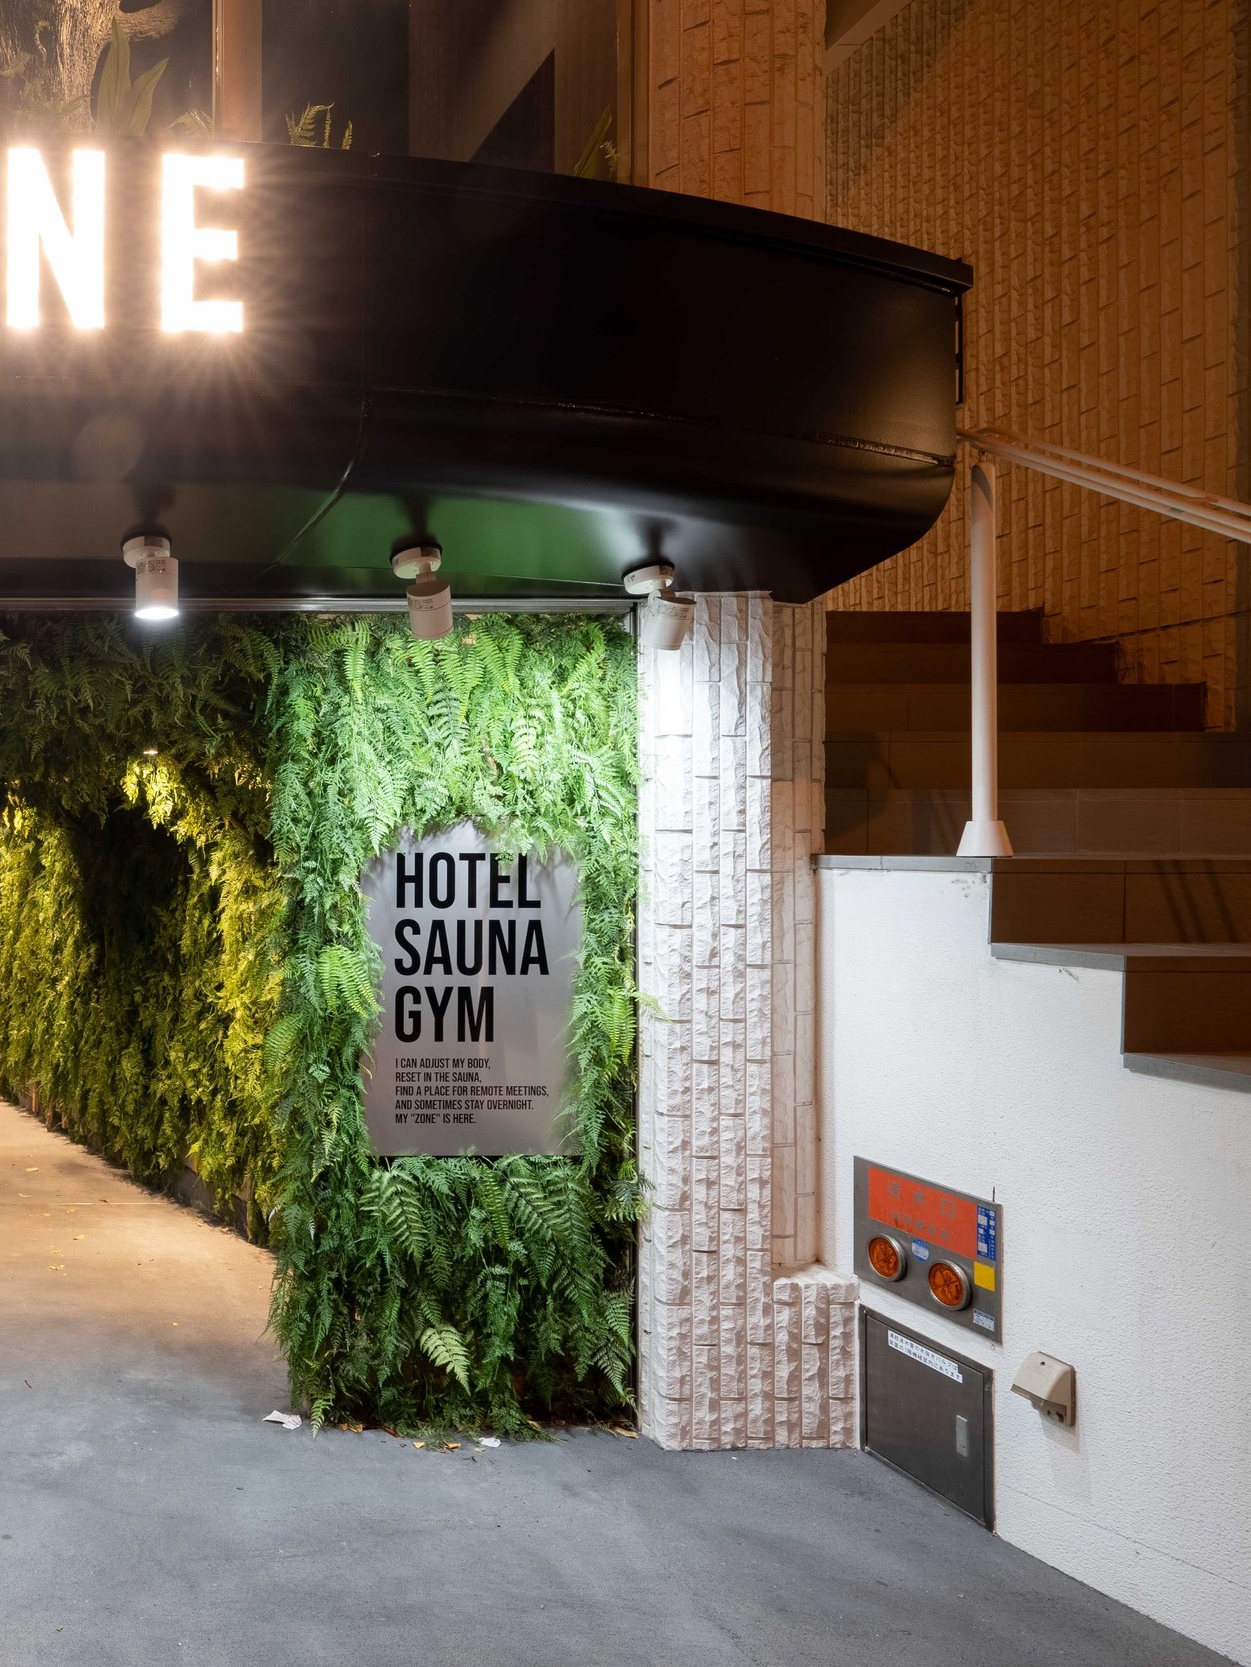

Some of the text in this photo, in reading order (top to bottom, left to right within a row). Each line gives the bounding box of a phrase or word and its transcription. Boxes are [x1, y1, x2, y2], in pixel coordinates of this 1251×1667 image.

[396, 852, 541, 909] HOTEL
[394, 918, 549, 976] SAUNA
[394, 986, 494, 1042] GYM
[395, 1058, 491, 1070] I CAN ADJUST MY BODY,
[395, 1072, 482, 1083] RESET IN THE SAUNA,
[395, 1086, 549, 1097] FIND A PLACE FOR REMOTE MEETINGS,
[395, 1100, 534, 1110] AND SOMETIMES STAY OVERNIGHT.
[395, 1113, 476, 1123] MY "ZONE" IS HERE.
